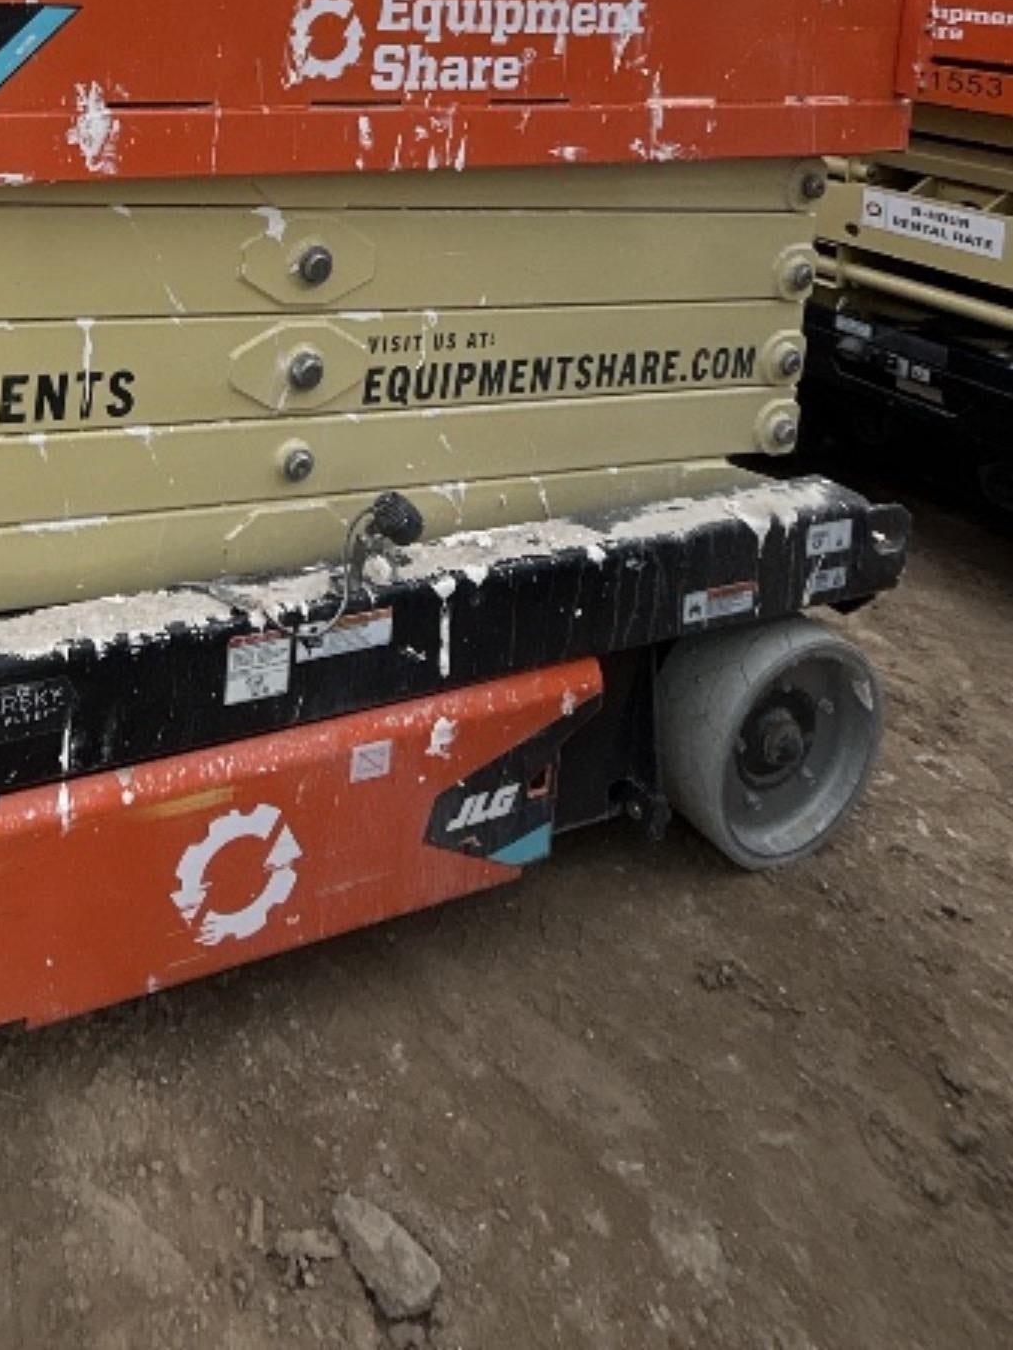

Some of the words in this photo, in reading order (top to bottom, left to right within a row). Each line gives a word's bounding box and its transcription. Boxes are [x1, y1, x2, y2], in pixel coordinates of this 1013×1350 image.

[371, 43, 522, 91] Share
[367, 334, 422, 354] VISIT
[433, 332, 456, 351] US
[465, 332, 495, 349] AT:
[362, 345, 757, 406] EQUIPMENTSHARE.COM
[445, 782, 523, 832] JLG
